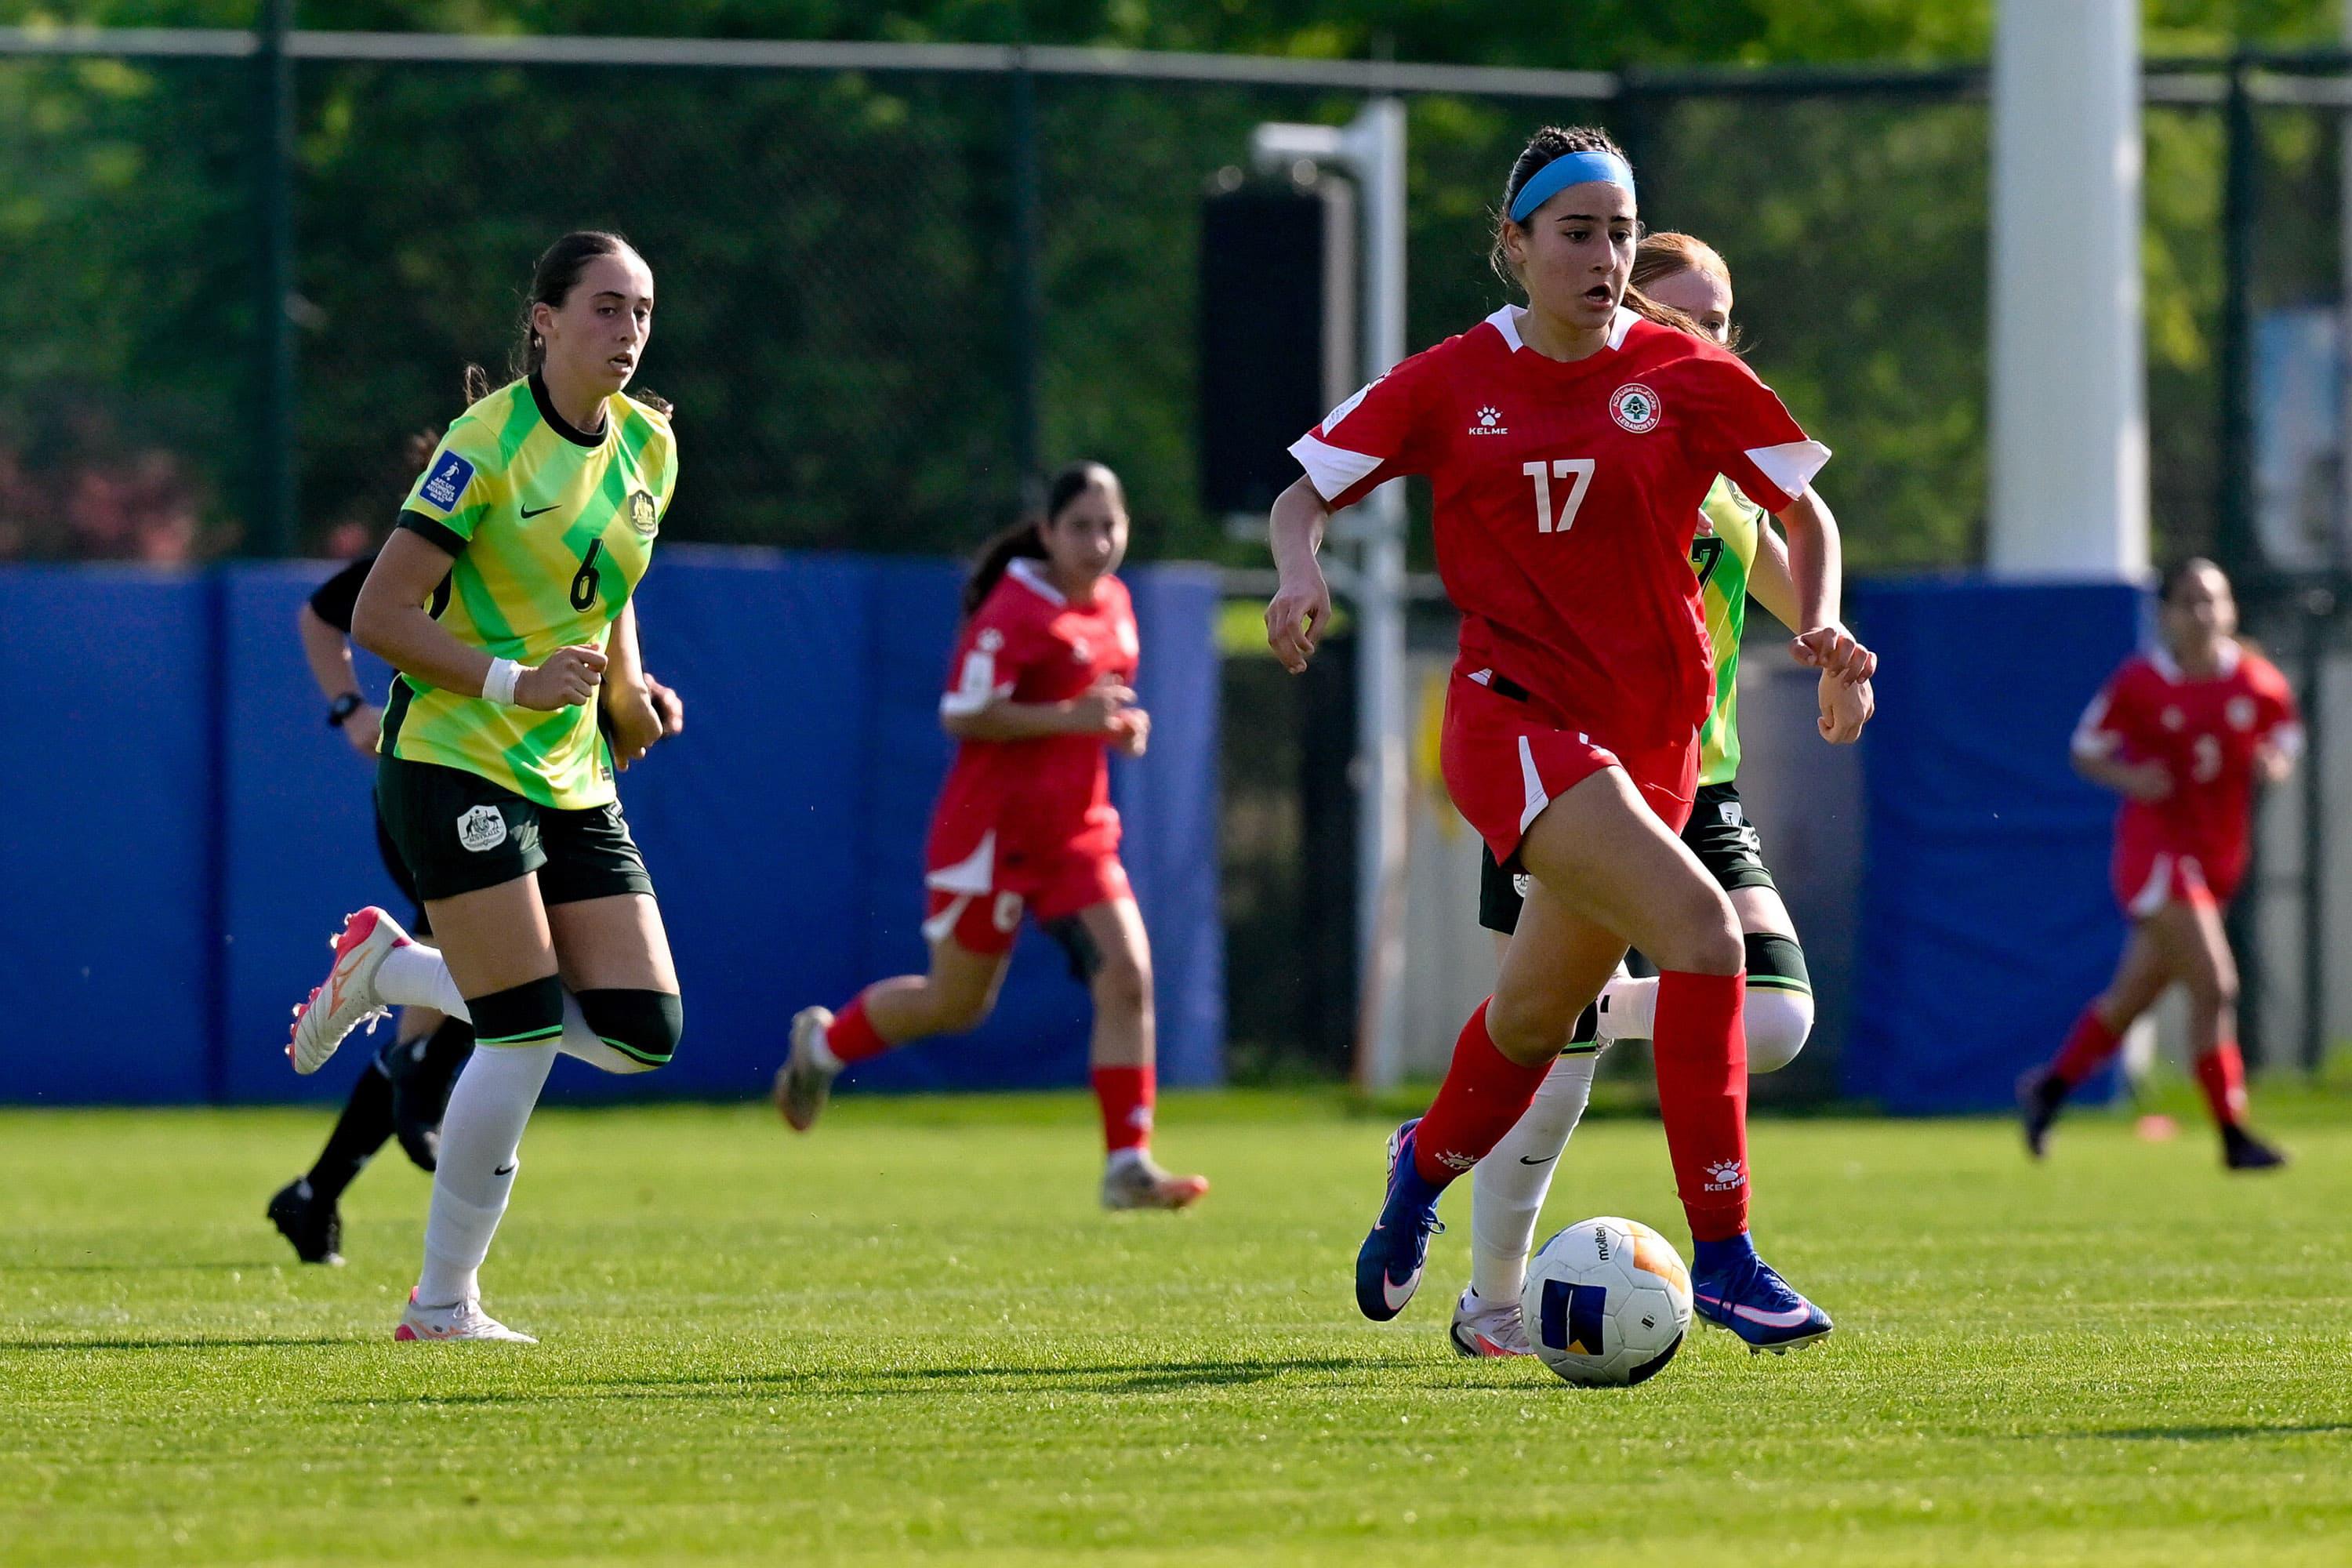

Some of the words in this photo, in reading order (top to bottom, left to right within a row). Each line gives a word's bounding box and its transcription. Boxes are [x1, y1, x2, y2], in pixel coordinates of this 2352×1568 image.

[1523, 459, 1595, 532] 17
[570, 539, 604, 613] 6
[1595, 1226, 1610, 1261] molten
